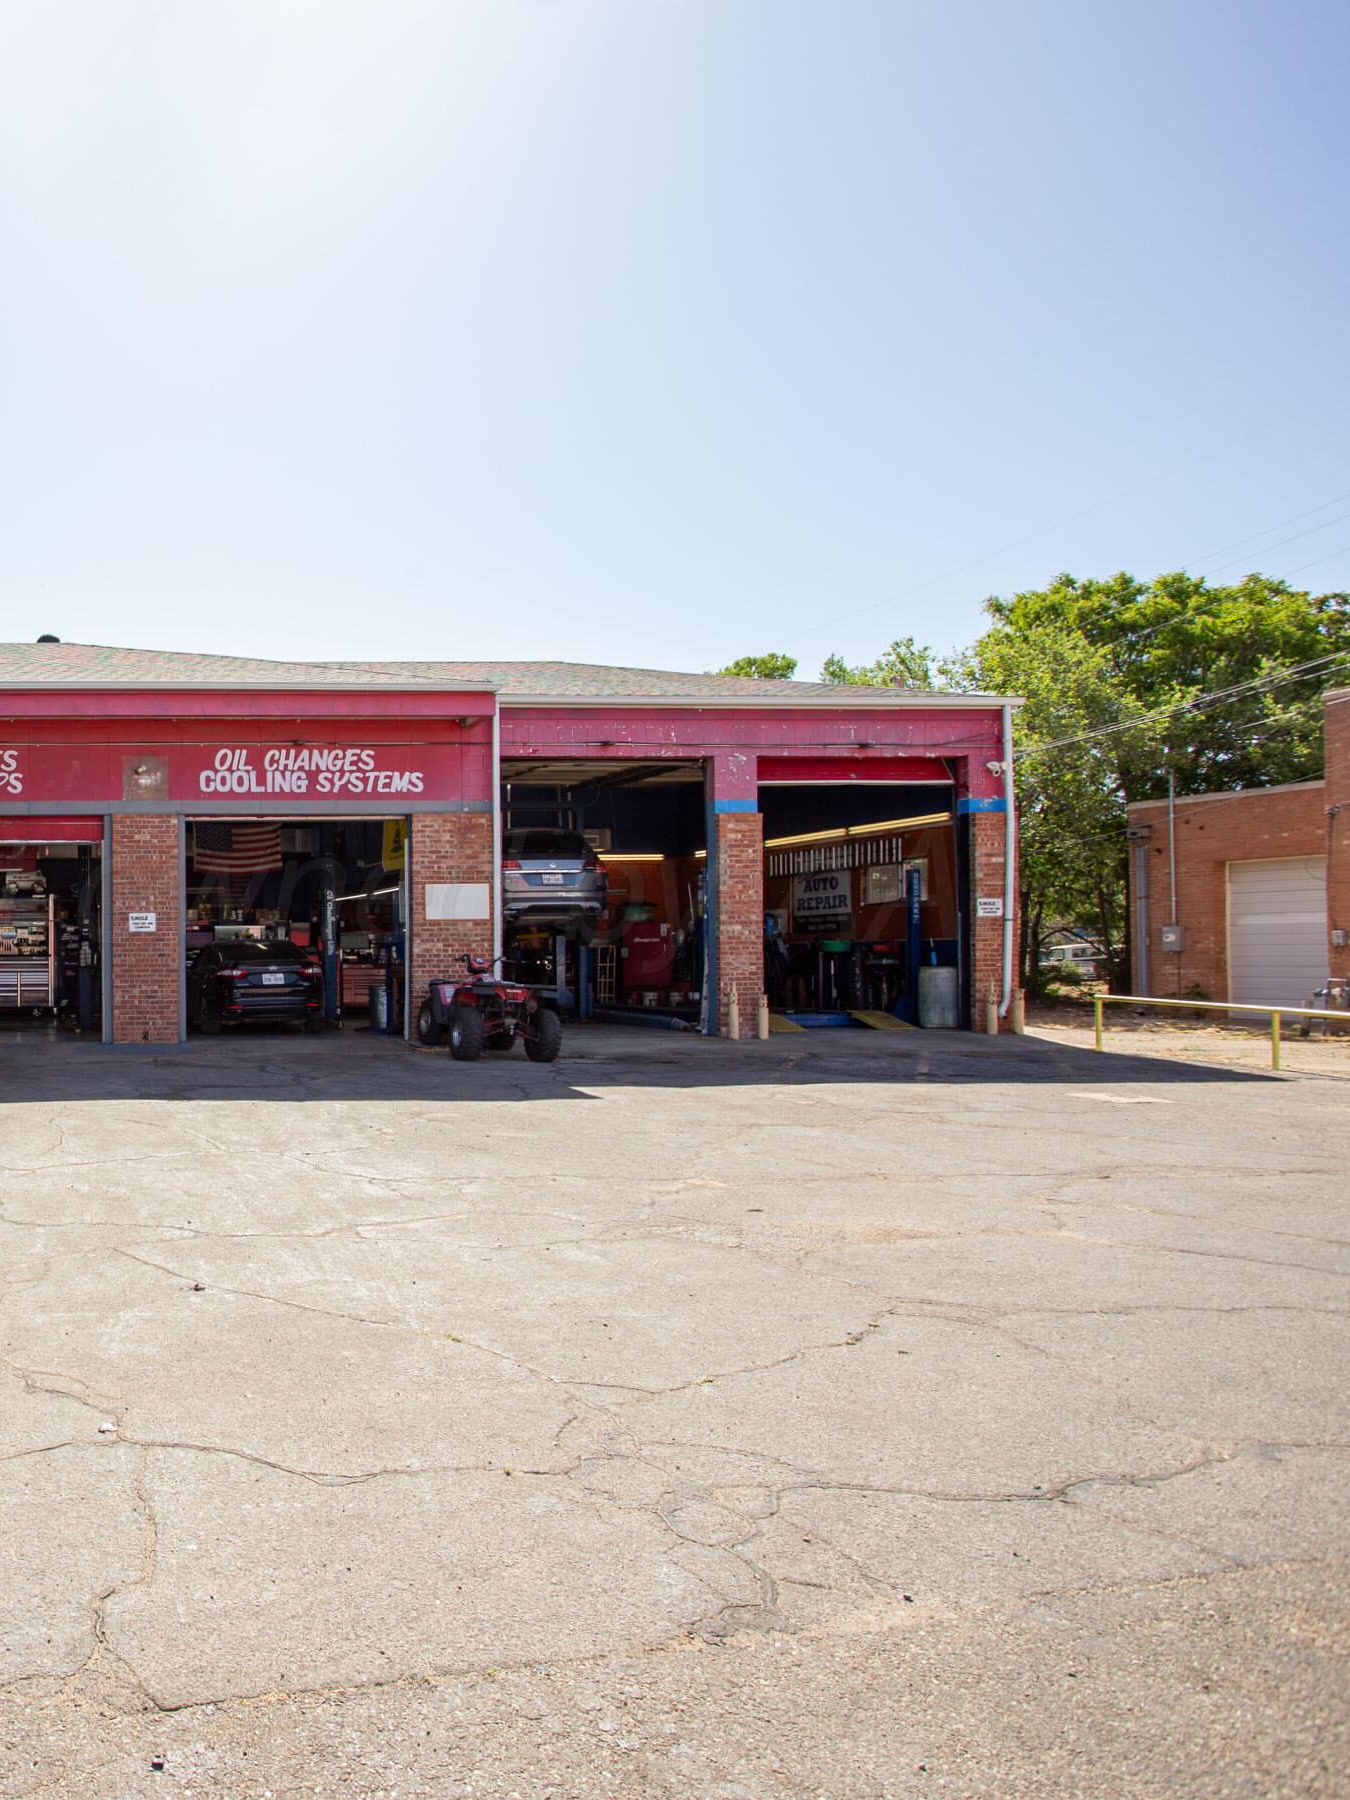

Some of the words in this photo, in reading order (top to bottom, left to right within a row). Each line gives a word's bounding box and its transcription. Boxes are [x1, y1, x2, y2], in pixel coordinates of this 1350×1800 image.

[214, 748, 253, 771] OIL
[264, 749, 376, 771] CHANGES
[200, 770, 309, 793] COOLING
[315, 771, 424, 793] SYSTEMS
[804, 877, 839, 892] AUTO
[797, 895, 848, 911] REPAIR
